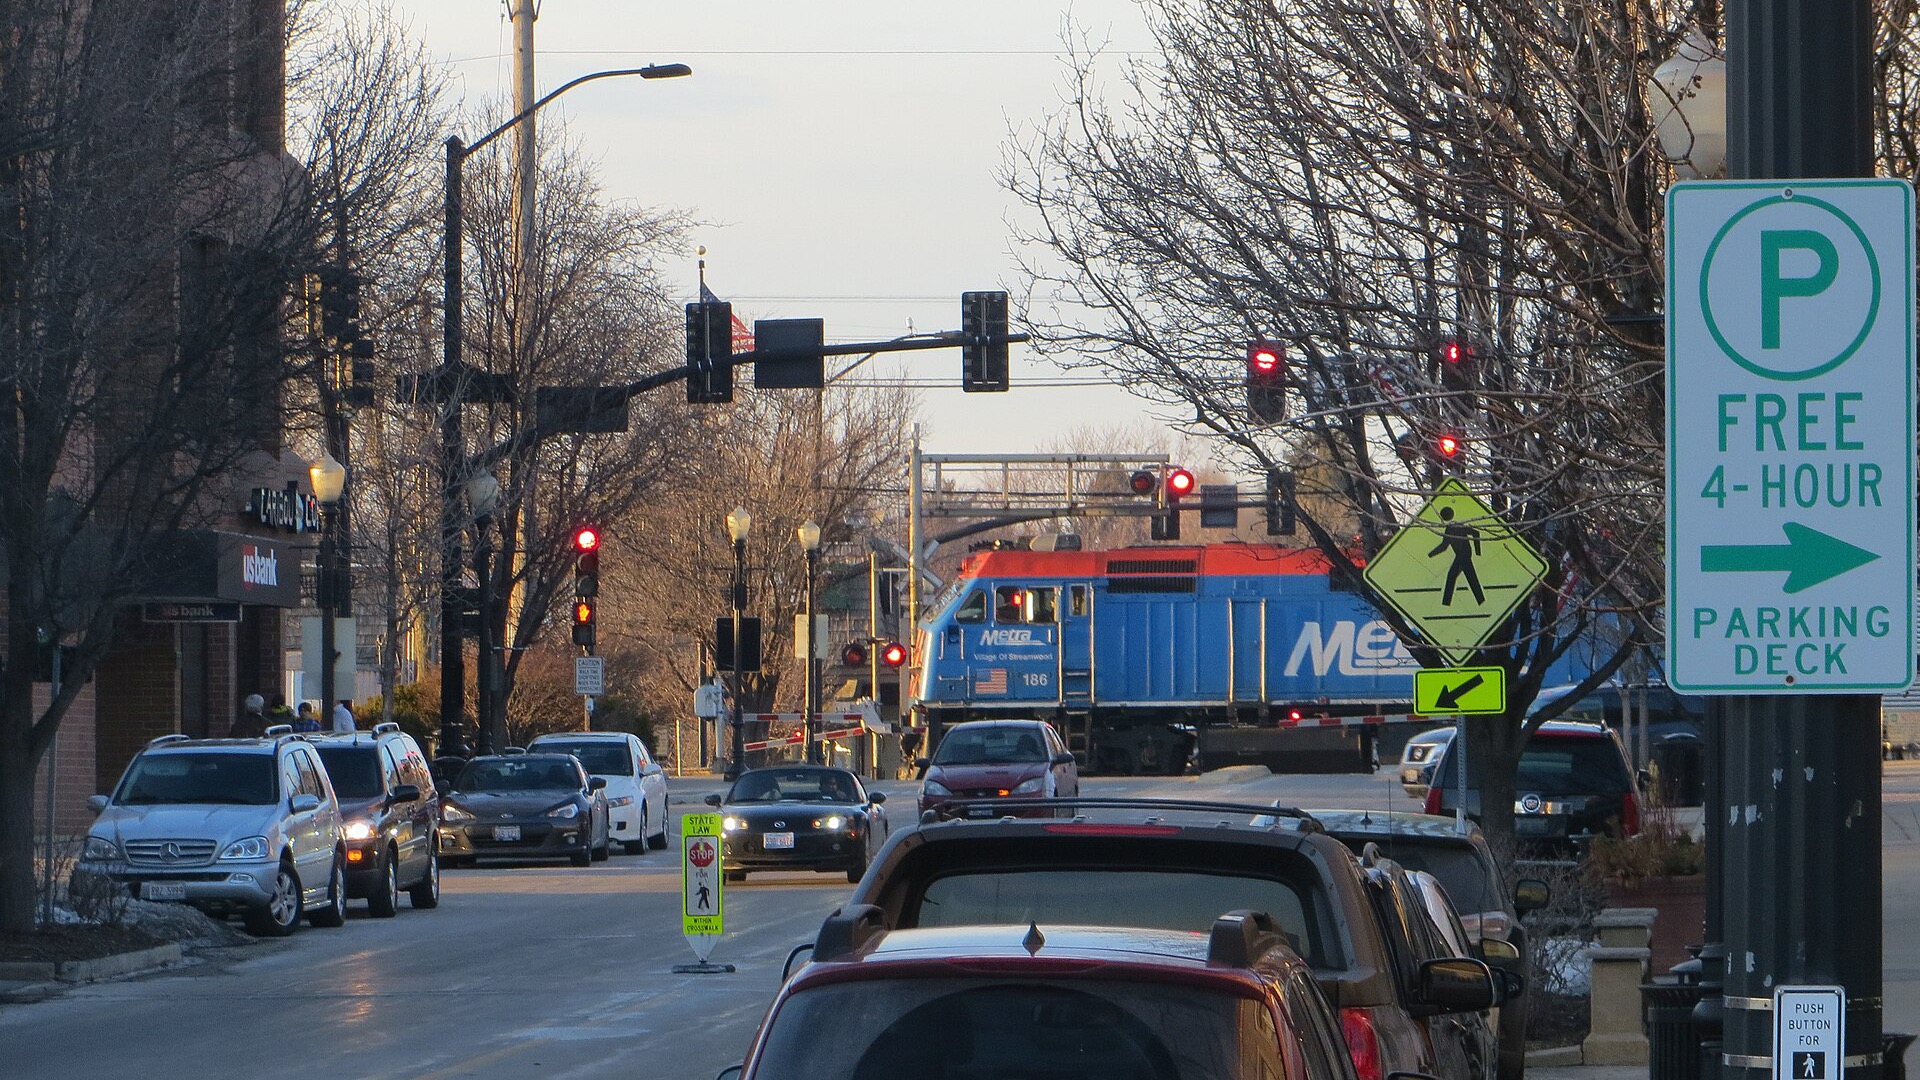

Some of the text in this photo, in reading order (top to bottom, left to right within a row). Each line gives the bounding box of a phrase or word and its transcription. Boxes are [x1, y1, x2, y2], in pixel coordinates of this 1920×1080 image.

[1761, 230, 1840, 350] P
[1718, 392, 1864, 452] FREE
[1700, 462, 1882, 508] 4-HOUR
[1693, 605, 1890, 638] PARKING
[980, 629, 1038, 646] Metra
[973, 652, 1053, 661] Village Of Streamwood
[1735, 643, 1848, 675] DECK
[1022, 673, 1048, 686] 186
[689, 817, 714, 825] STATE
[692, 826, 710, 834] LAW
[690, 850, 714, 860] STOP
[1795, 1003, 1824, 1014] PUSH
[1788, 1019, 1831, 1030] BUTTON
[1799, 1035, 1820, 1046] FOR
